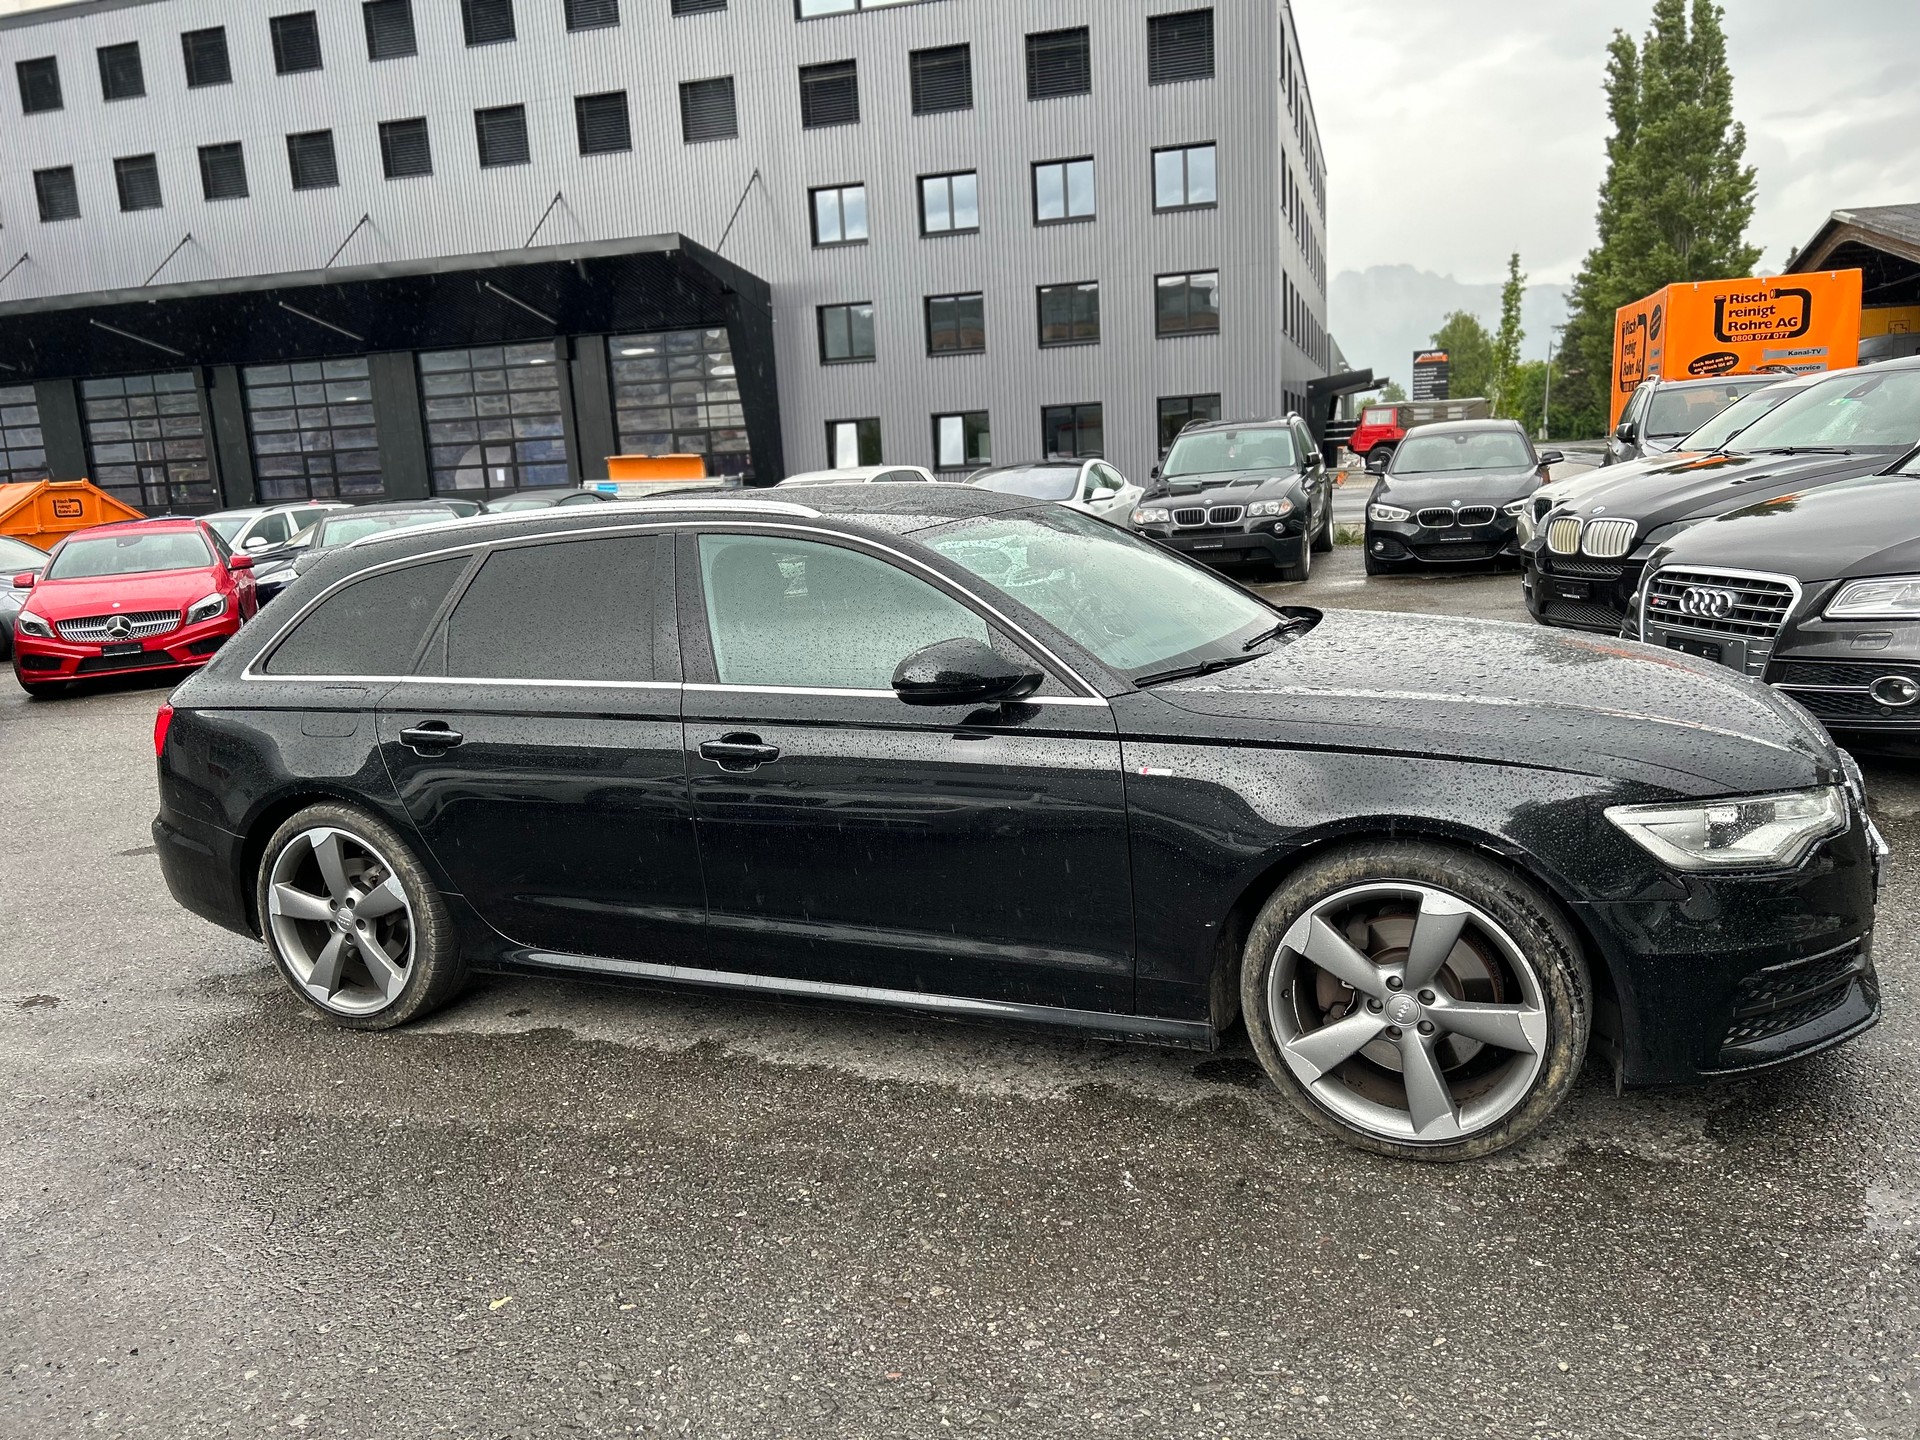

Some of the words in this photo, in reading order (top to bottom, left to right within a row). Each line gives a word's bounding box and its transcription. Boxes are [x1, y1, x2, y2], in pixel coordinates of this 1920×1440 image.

[1729, 292, 1767, 304] Risch
[1728, 305, 1776, 318] reinigt
[1728, 320, 1772, 332] Rohre
[1775, 317, 1798, 328] AG
[1788, 348, 1822, 356] Kanal-TV
